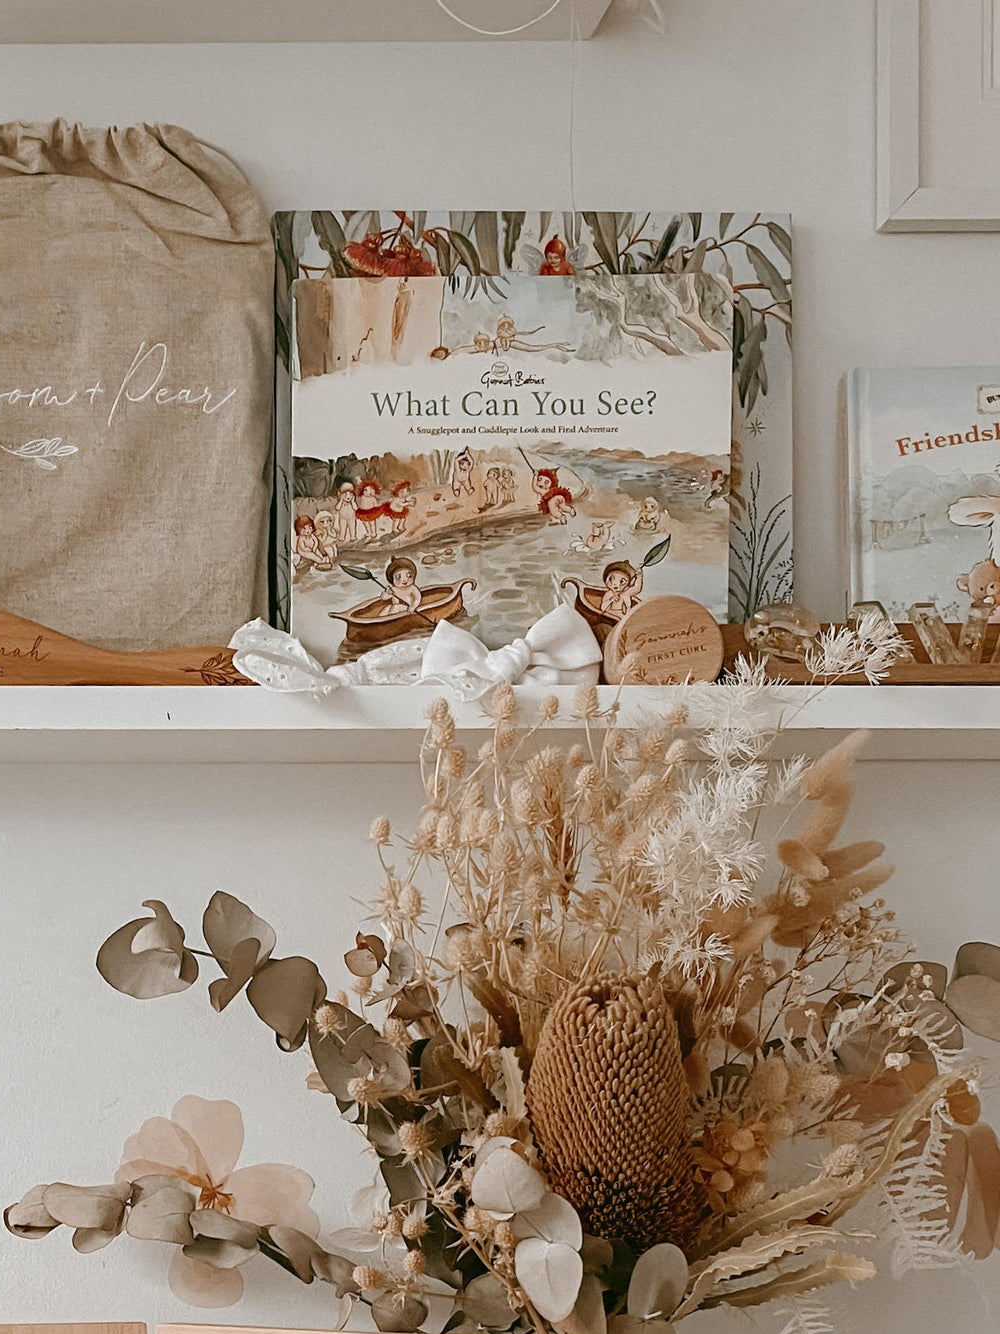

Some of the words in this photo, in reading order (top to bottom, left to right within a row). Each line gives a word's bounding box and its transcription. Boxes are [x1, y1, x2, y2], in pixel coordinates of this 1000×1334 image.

[107, 340, 236, 427] Pear
[371, 390, 451, 417] What
[461, 391, 519, 417] Can
[531, 391, 586, 416] You
[597, 390, 658, 416] See?
[408, 426, 415, 434] A
[416, 426, 460, 436] Snugglepot
[461, 426, 476, 434] and
[519, 426, 540, 434] Look
[541, 426, 556, 434] and
[558, 426, 576, 434] Find
[578, 425, 619, 434] Adventure
[647, 650, 675, 664] FIRST
[679, 644, 707, 656] CURL
